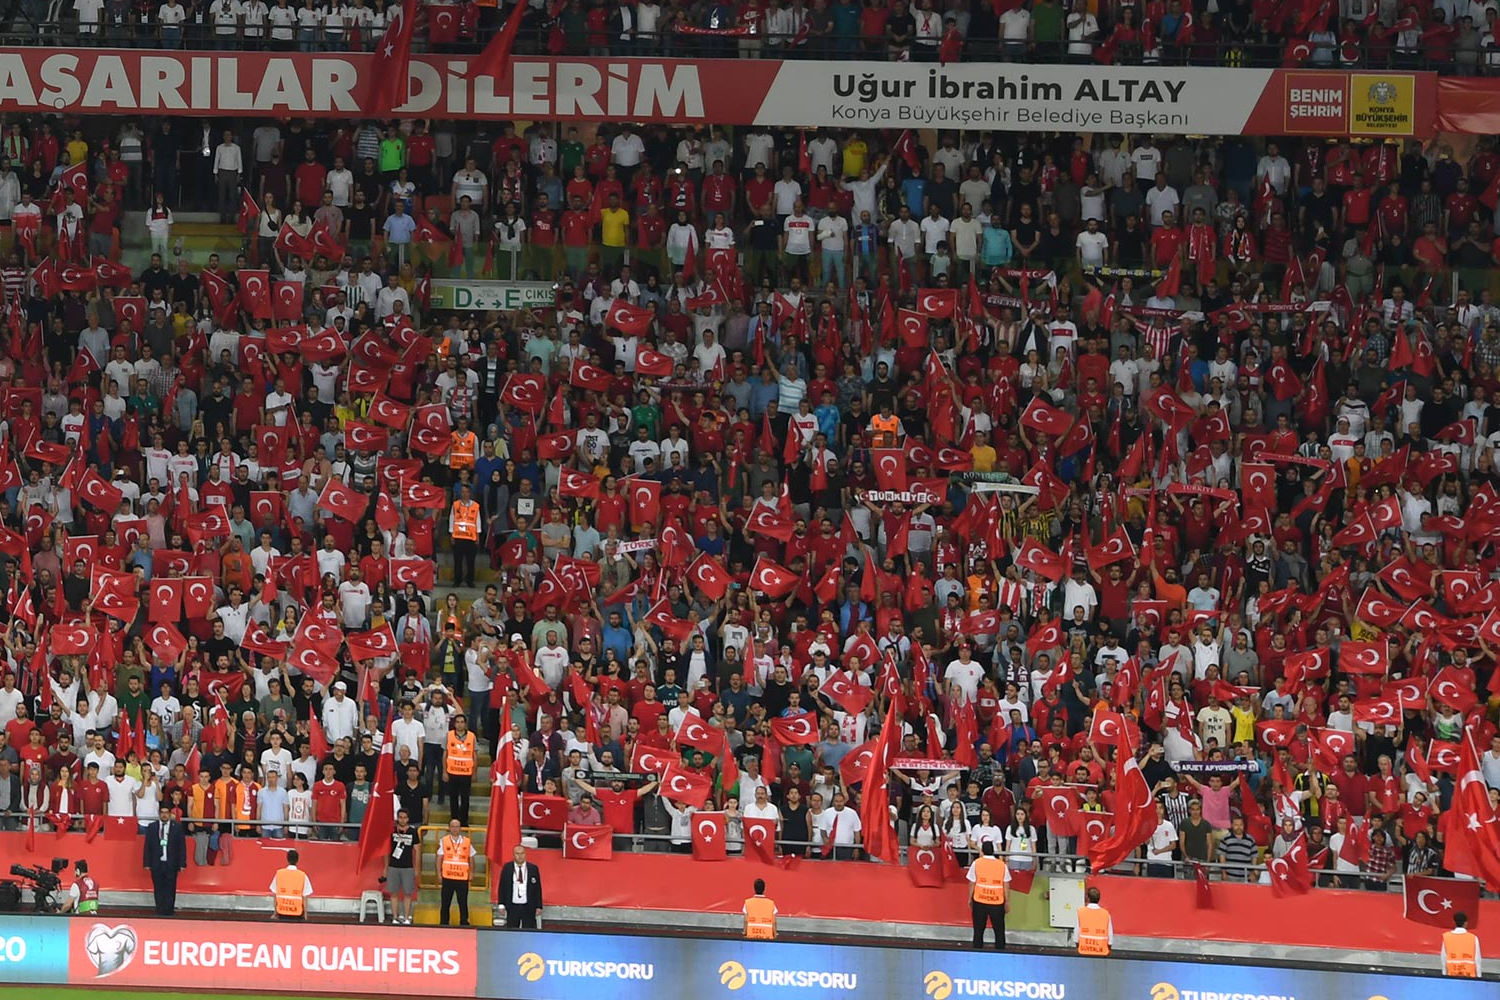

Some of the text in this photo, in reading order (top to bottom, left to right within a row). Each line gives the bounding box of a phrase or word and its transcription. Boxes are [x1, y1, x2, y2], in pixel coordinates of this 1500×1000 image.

[833, 68, 1187, 104] Uğur İbrahim ALTAY
[832, 104, 1189, 129] Konya Büyükşehir Belediye Başkanı
[455, 288, 520, 309] D E
[1181, 485, 1214, 493] TÜRKİYE
[143, 940, 460, 975] EUROPEAN QUALIFIERS
[546, 959, 654, 980] TURKSPORU
[748, 968, 857, 989] TURKSPORU
[953, 978, 1065, 1000] TURKSPORU
